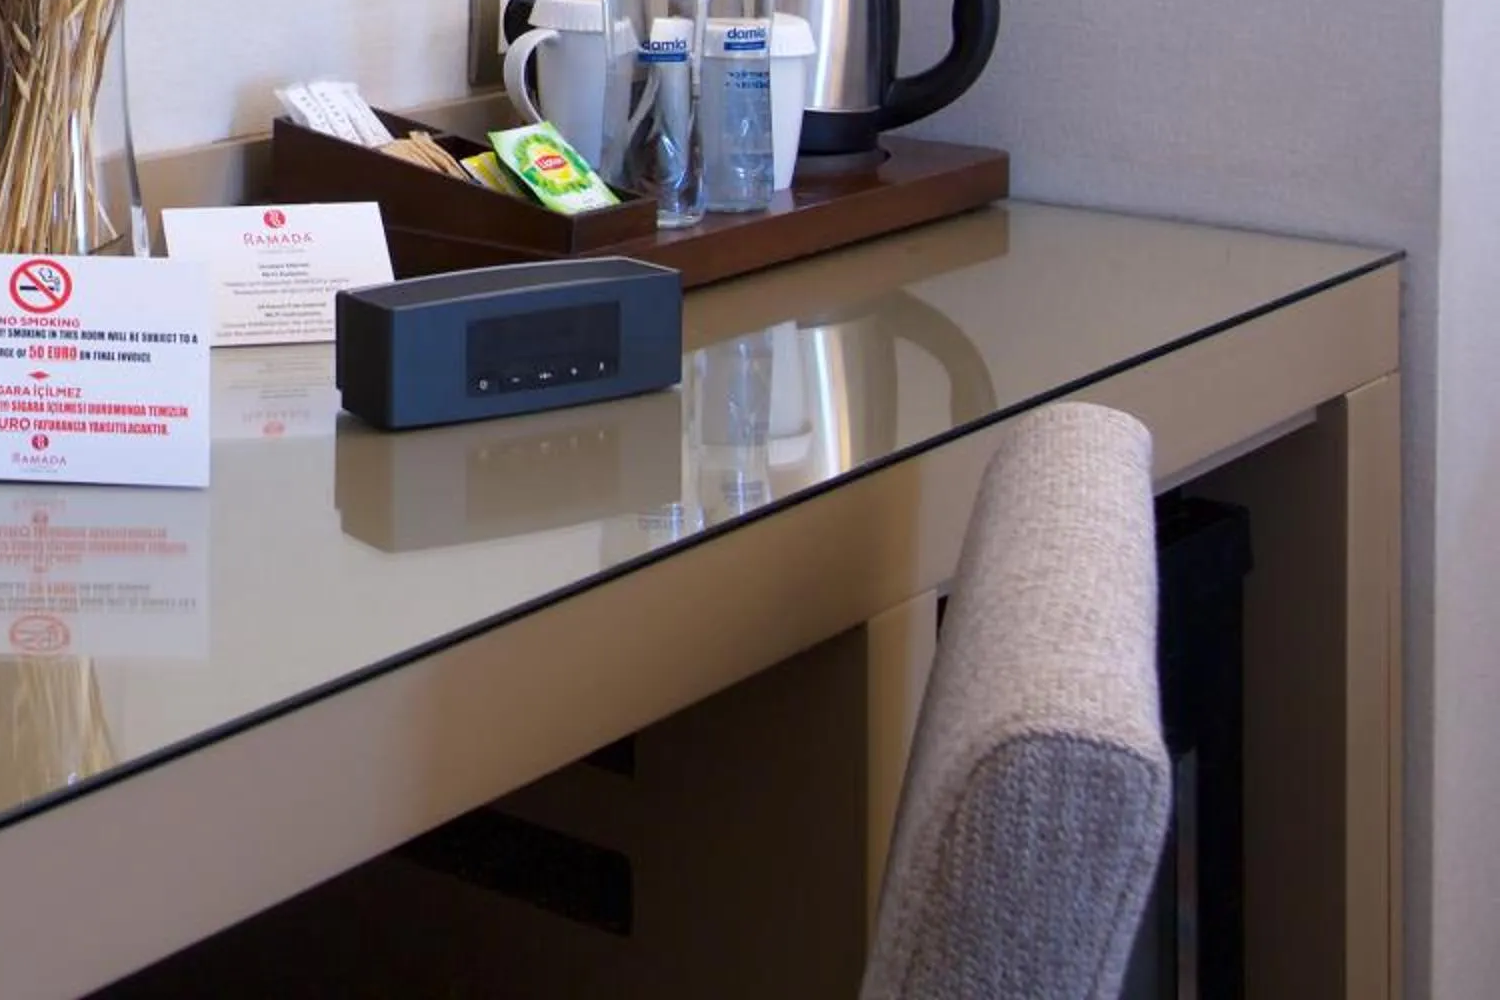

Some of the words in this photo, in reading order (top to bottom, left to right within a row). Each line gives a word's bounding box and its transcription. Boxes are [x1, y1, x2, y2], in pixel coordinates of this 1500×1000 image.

[243, 232, 313, 246] RAMADA
[20, 317, 80, 328] SMOKING
[28, 345, 45, 360] 50
[47, 346, 77, 361] EURO
